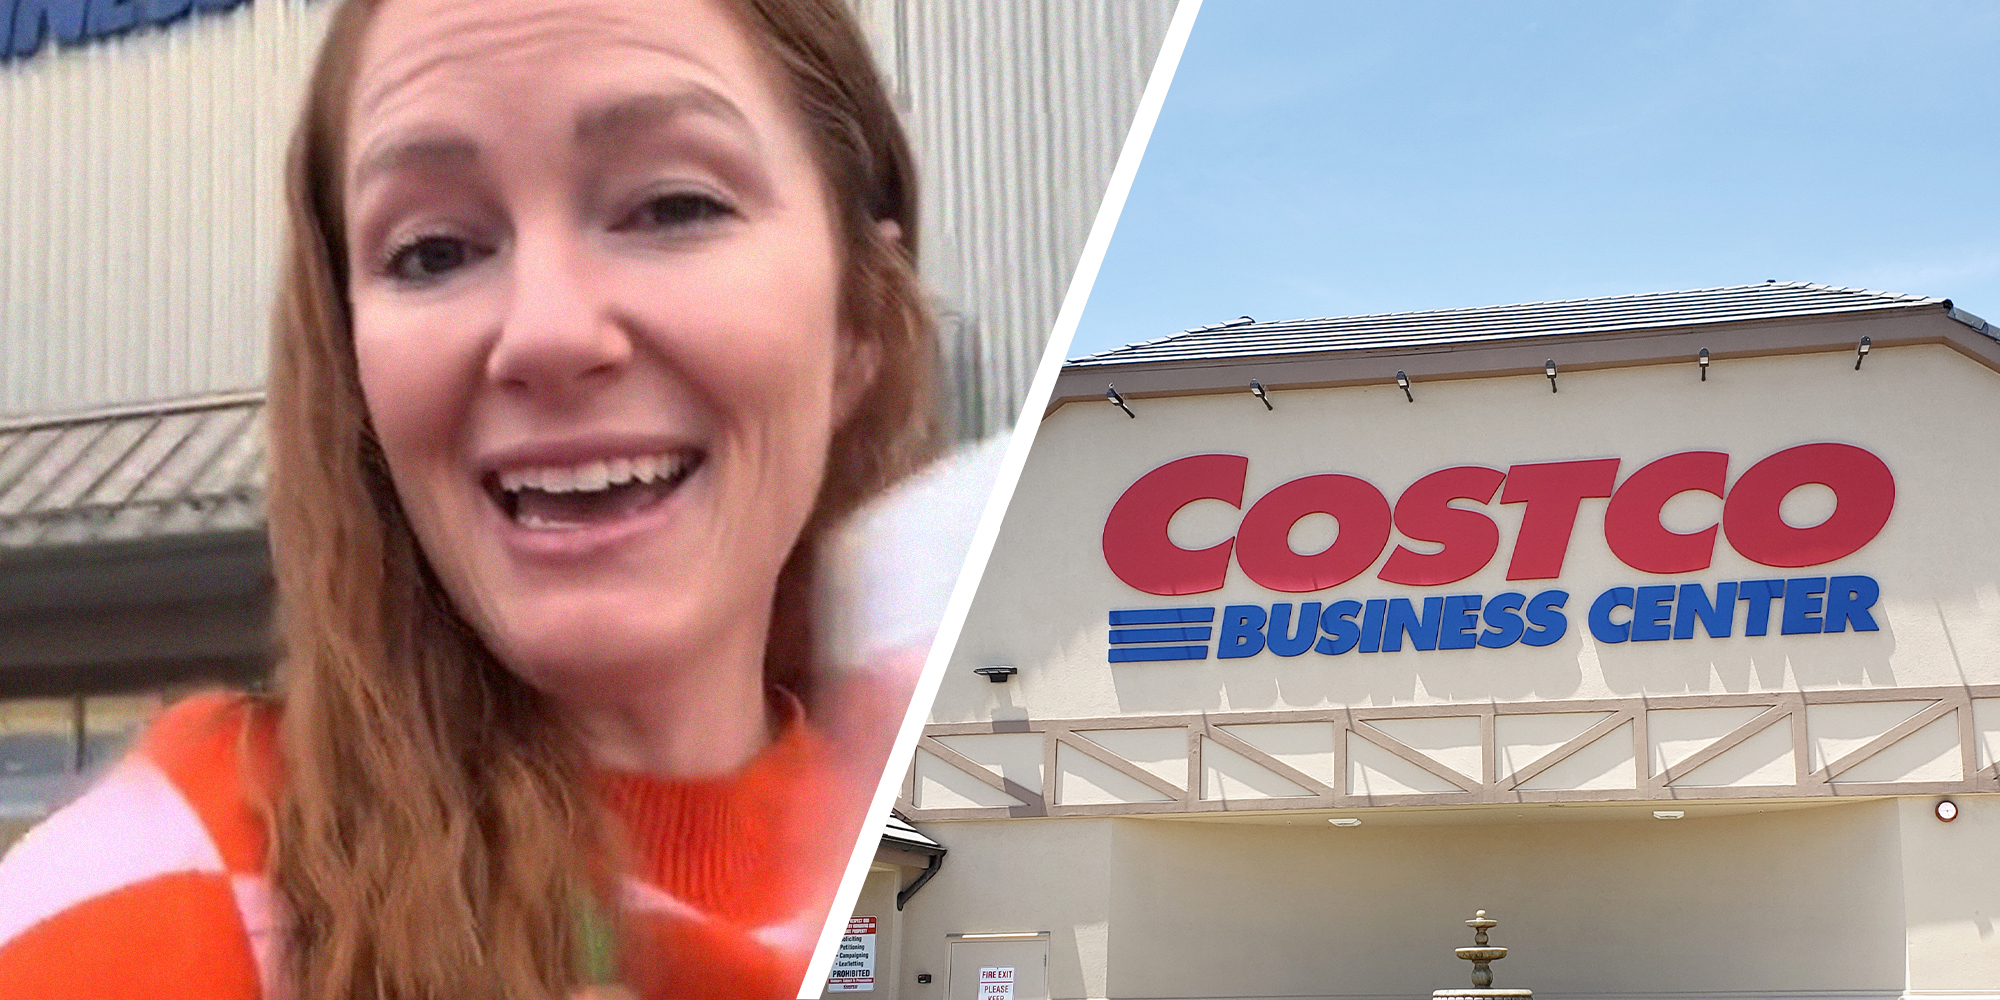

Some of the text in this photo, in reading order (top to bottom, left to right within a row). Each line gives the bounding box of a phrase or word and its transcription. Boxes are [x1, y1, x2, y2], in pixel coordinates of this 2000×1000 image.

[1102, 442, 1896, 596] COSTCO
[1216, 574, 1880, 659] BUSINESS CENTER
[984, 985, 1009, 993] PLEASE
[998, 970, 1012, 978] EXIT
